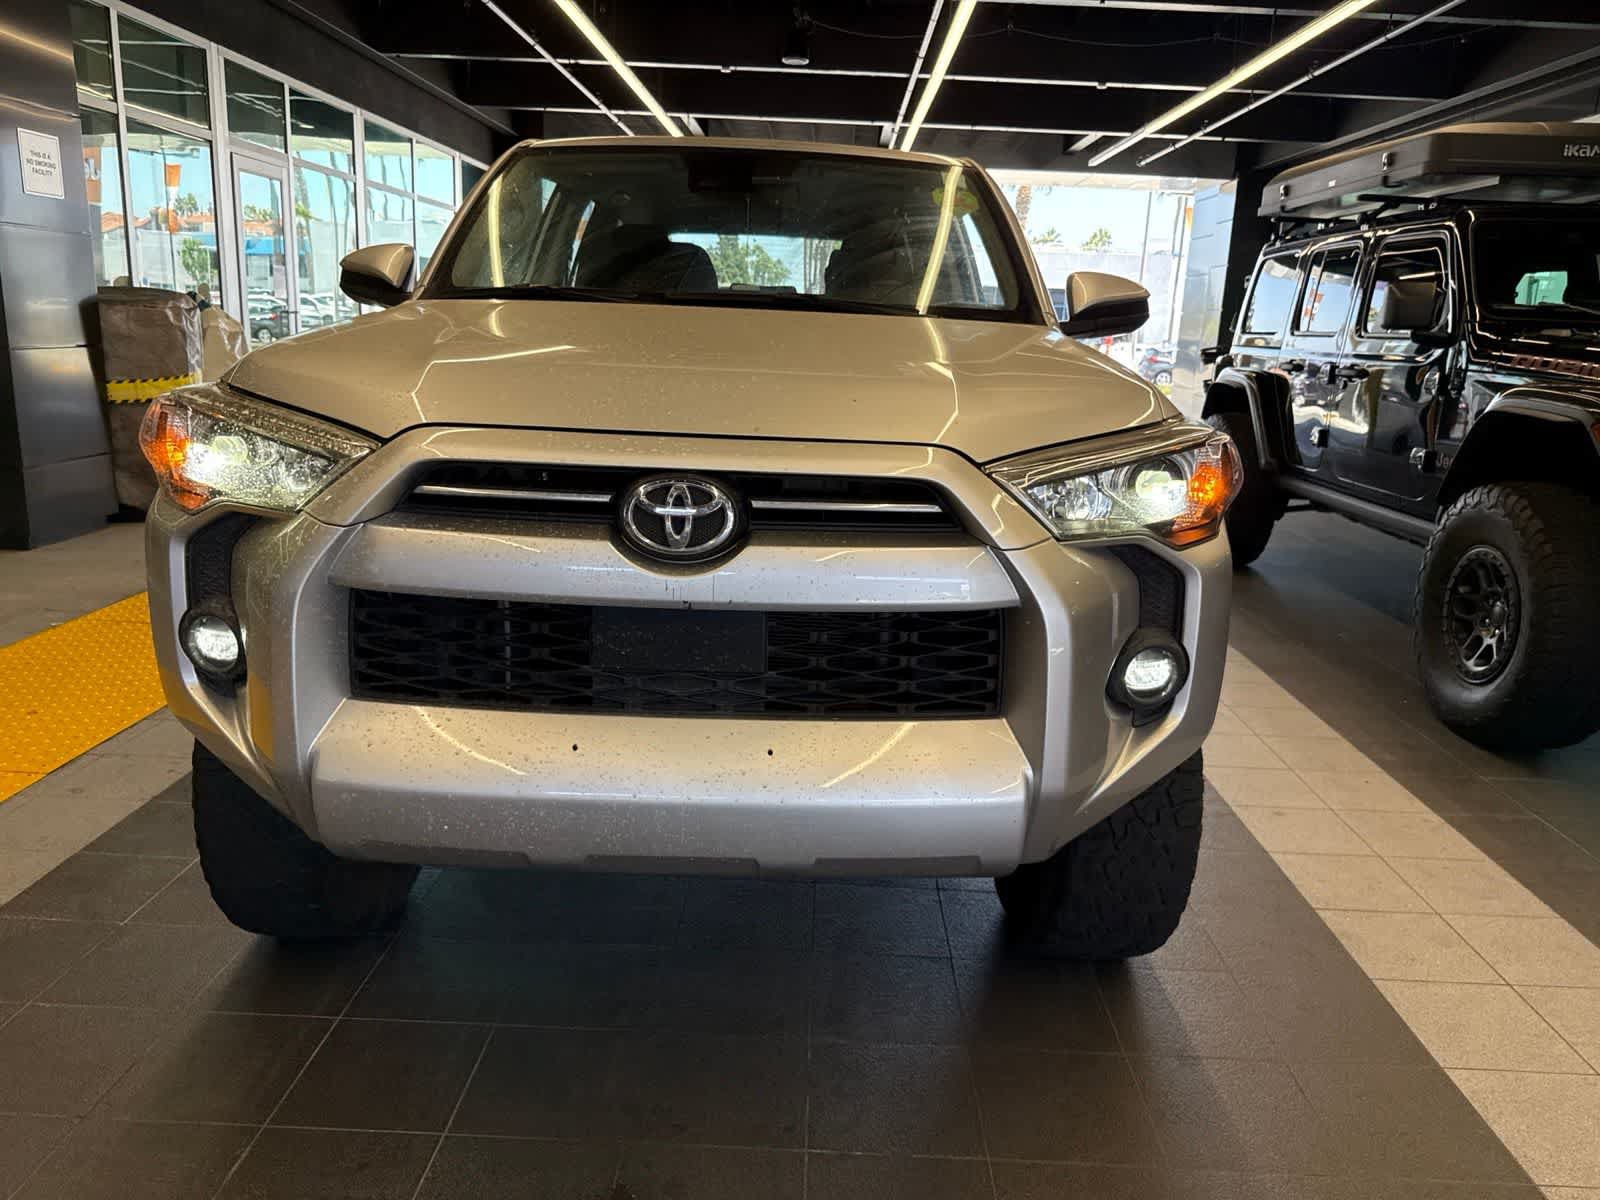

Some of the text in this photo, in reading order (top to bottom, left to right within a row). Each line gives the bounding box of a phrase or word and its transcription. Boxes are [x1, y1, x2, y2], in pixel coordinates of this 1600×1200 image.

[30, 150, 41, 158] THIS
[26, 158, 56, 169] NO SMOKING
[32, 167, 53, 177] FACILITY
